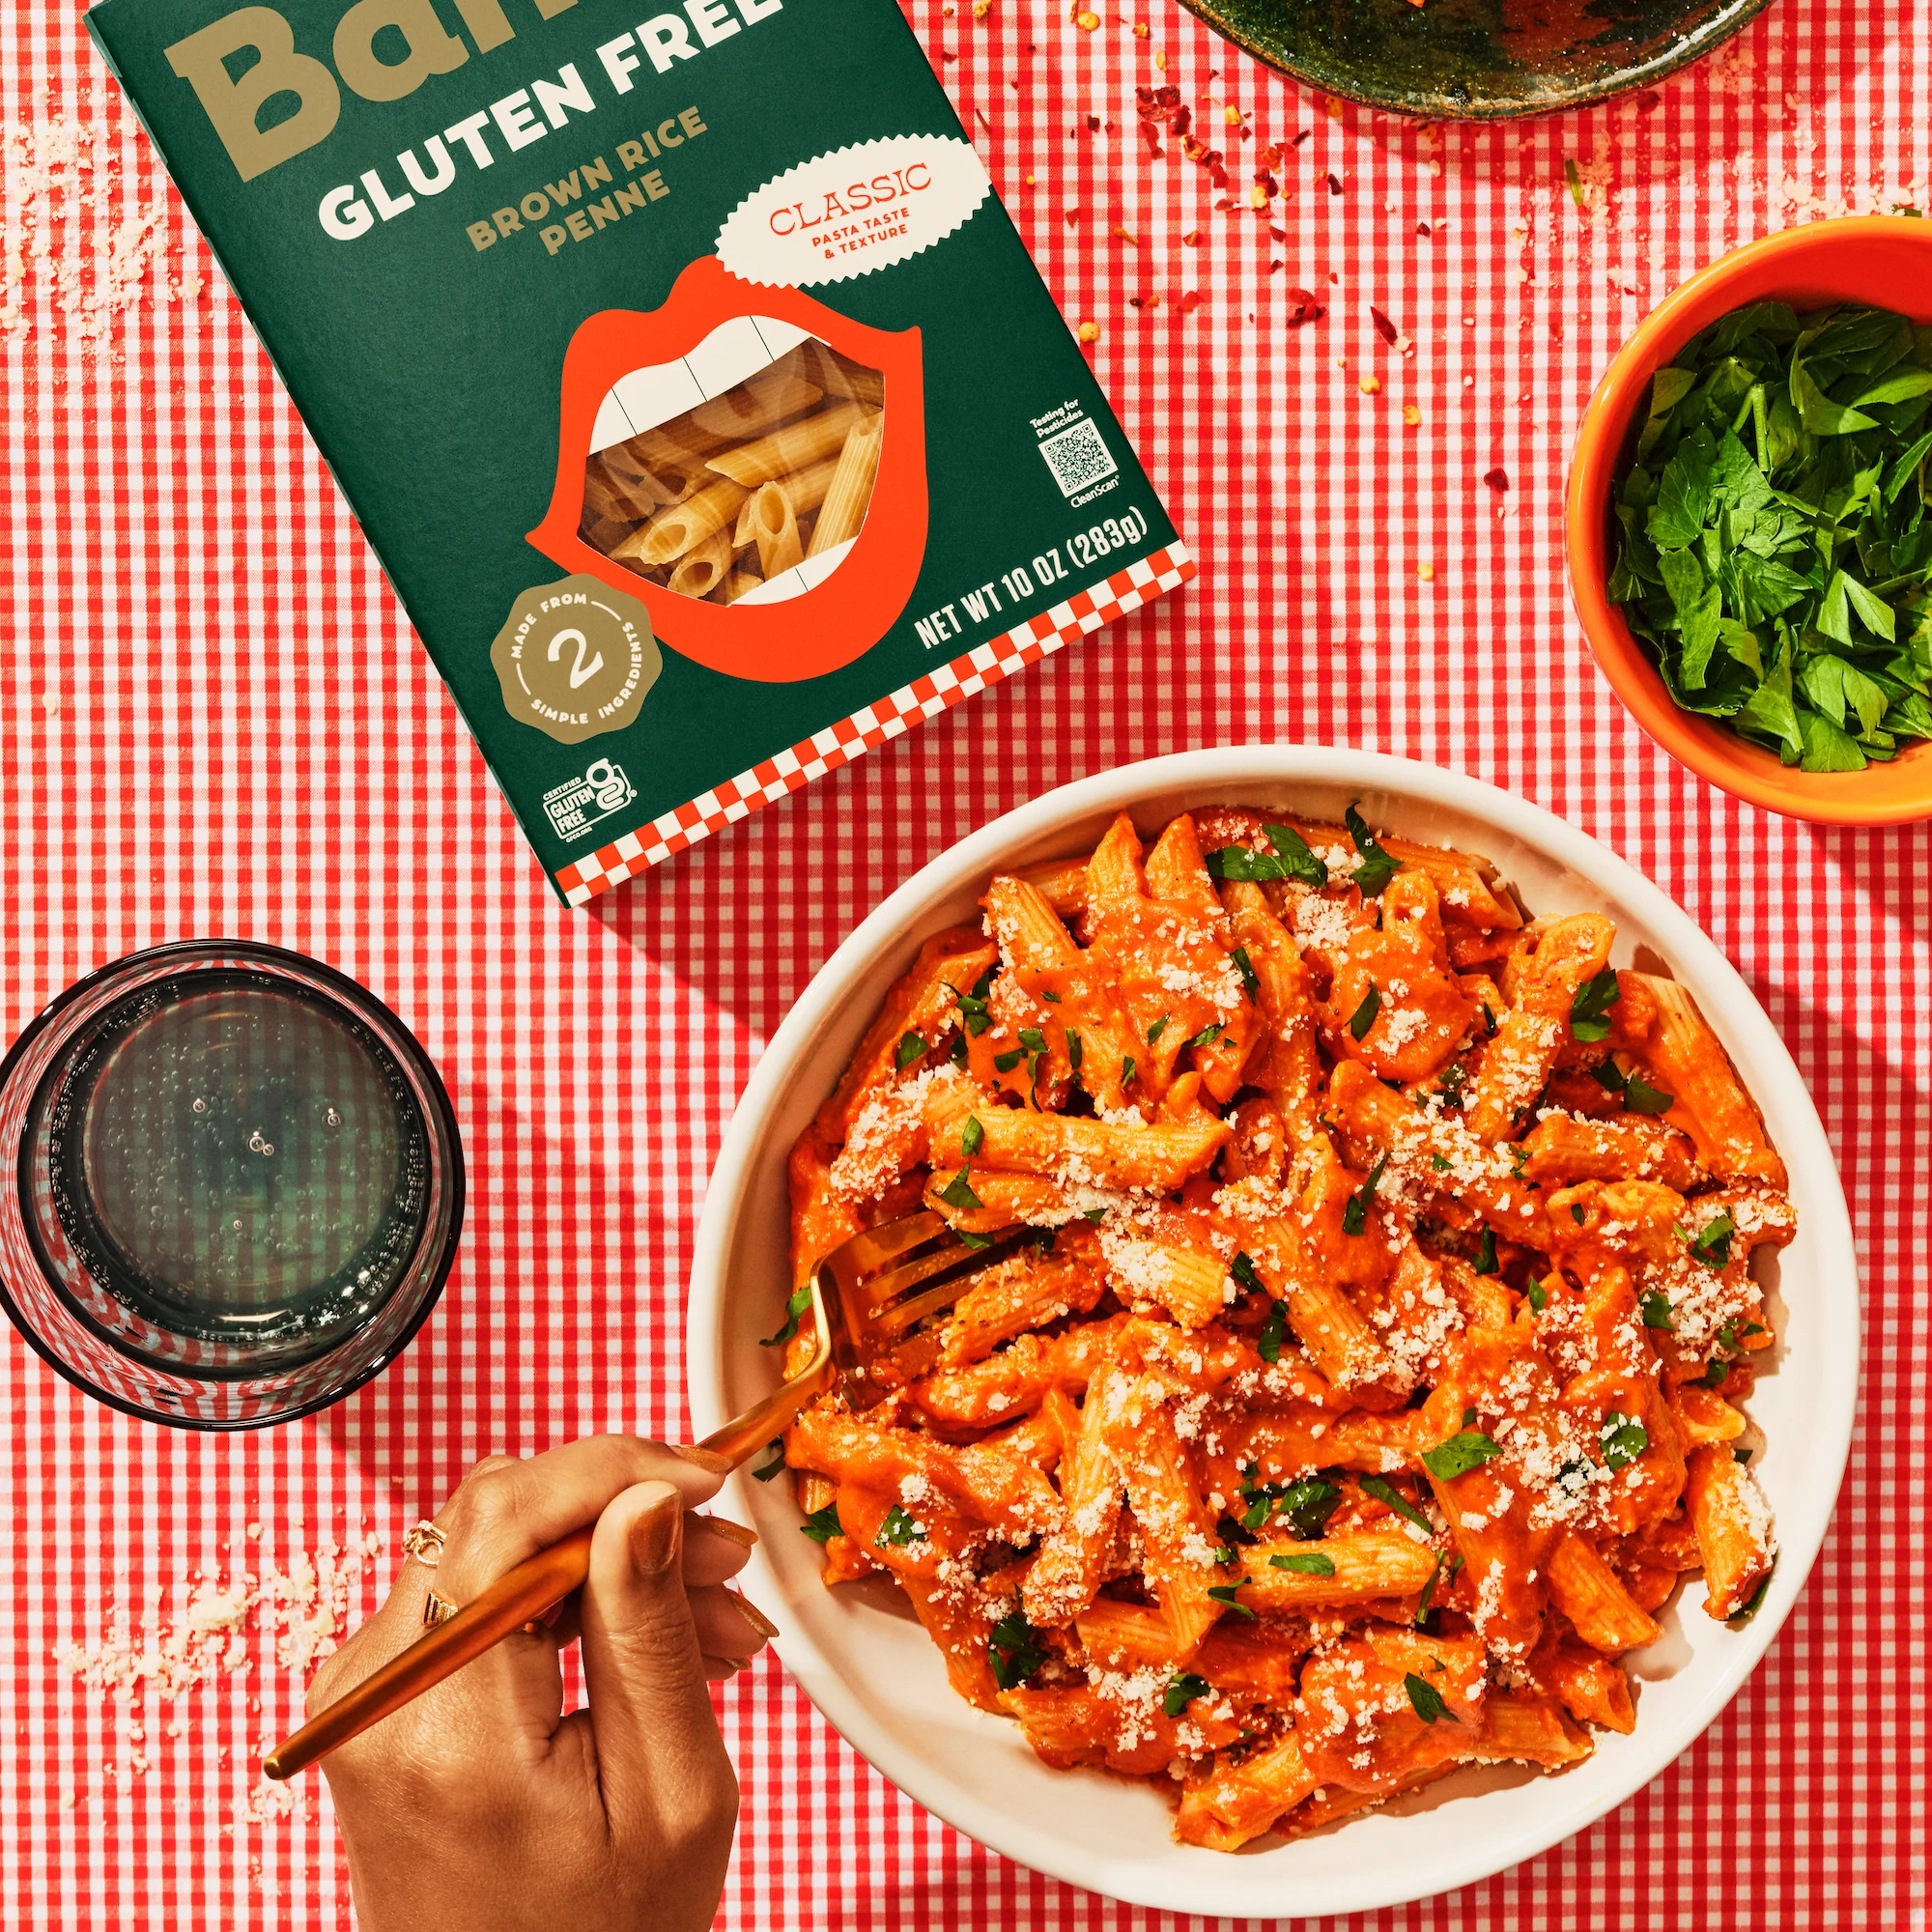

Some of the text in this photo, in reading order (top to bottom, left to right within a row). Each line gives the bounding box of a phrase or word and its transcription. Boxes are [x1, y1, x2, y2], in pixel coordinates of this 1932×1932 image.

[318, 62, 596, 242] GLUTEN
[466, 105, 708, 252] BROWN RICE
[770, 162, 932, 236] CLASSIC
[539, 169, 670, 256] PENNE
[811, 207, 911, 247] PASTA TASTE
[824, 223, 909, 260] & TEXTURE
[1030, 399, 1079, 428] Testing for
[1036, 410, 1084, 438] Pesticides
[1070, 479, 1119, 508] CleanScan
[914, 505, 1148, 650] NET WT 10 OZ (283g)
[511, 592, 587, 659] MADE FROM
[530, 622, 642, 724] SIMPLE INGREDIENTS
[547, 628, 604, 689] 2
[543, 777, 581, 800] CERTIFIED
[550, 785, 596, 819] GLUTEN
[556, 809, 586, 833] FREE
